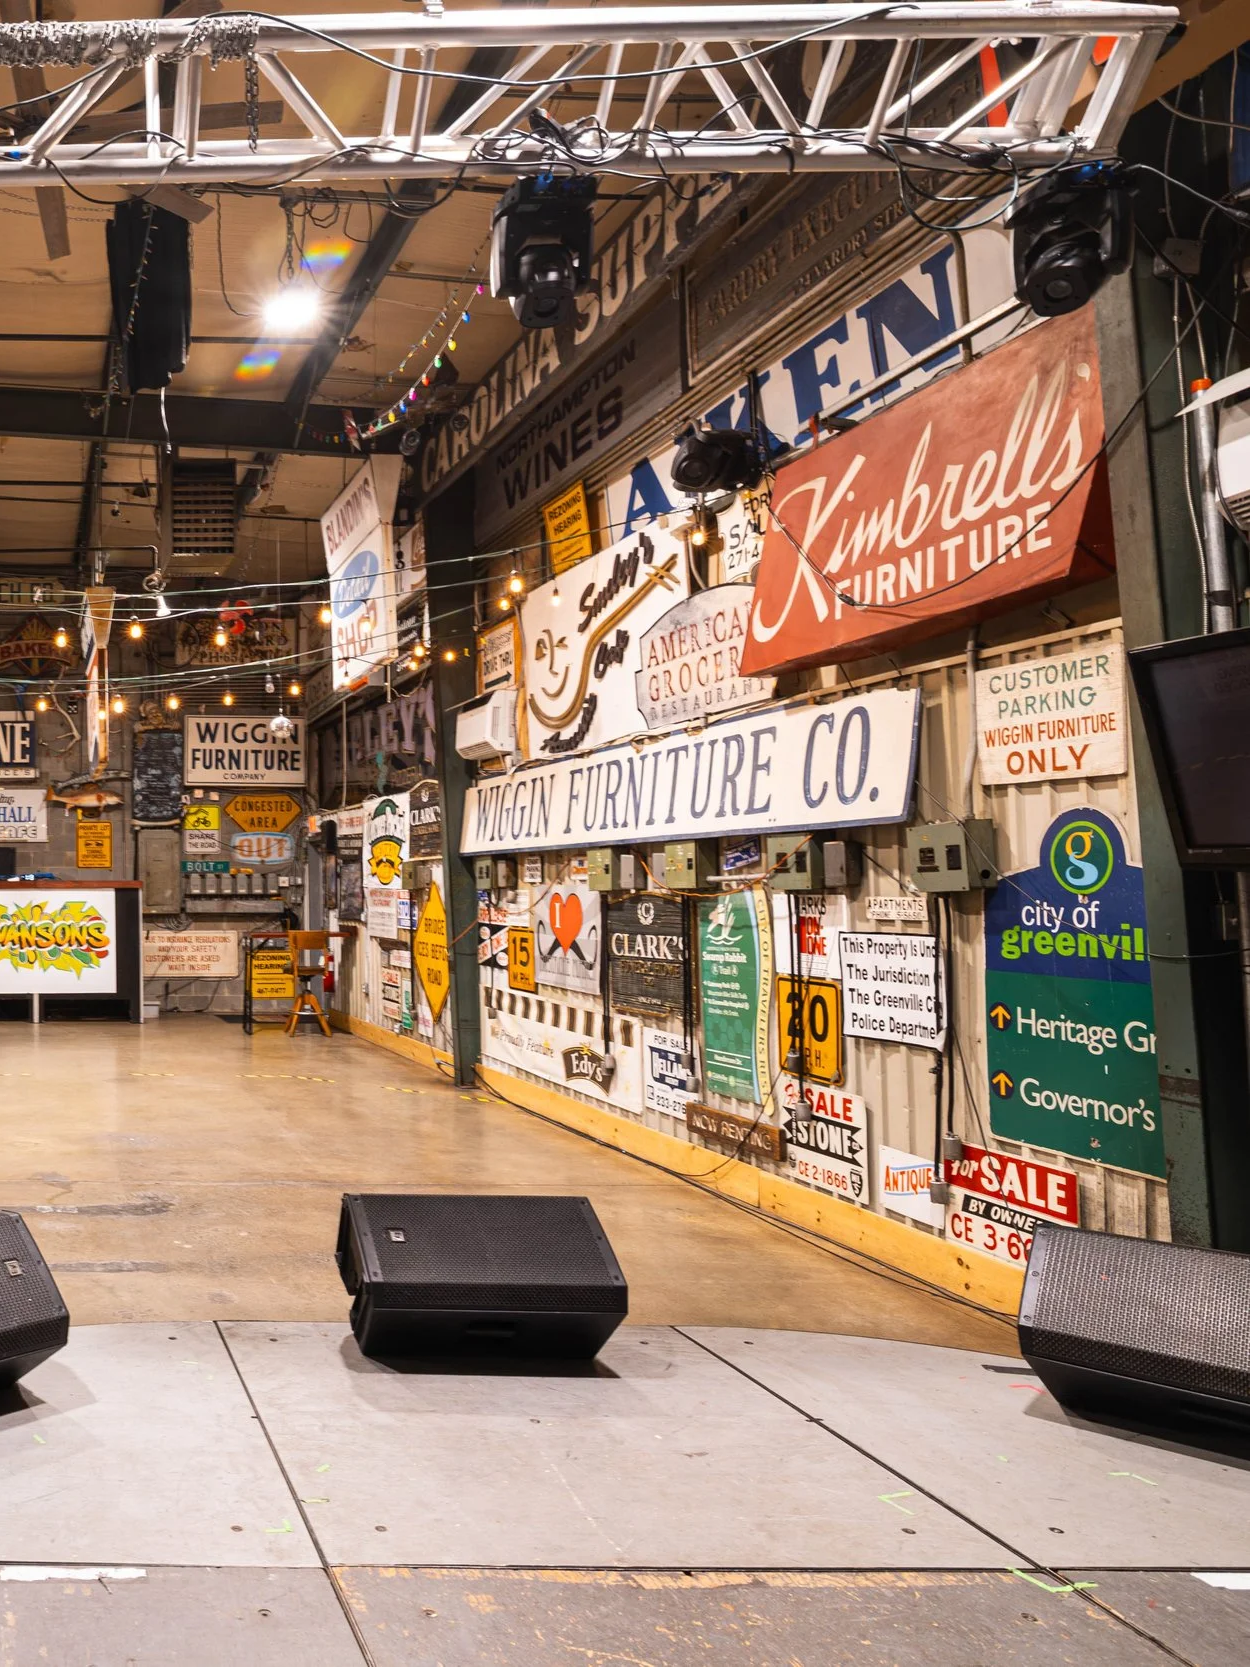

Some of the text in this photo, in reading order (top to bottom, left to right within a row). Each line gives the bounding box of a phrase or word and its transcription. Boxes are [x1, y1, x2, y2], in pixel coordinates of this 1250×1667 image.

[421, 328, 562, 494] CAROLINA
[496, 339, 638, 475] NORTHAMPTON
[502, 386, 625, 511] WINES
[547, 490, 582, 523] REZONING
[553, 510, 583, 536] HEARING
[833, 502, 1051, 620] FURNITURE
[336, 599, 378, 660] SHOP
[649, 645, 743, 703] GROCER
[988, 654, 1111, 696] CUSTOMER
[997, 685, 1097, 720] PARKING
[195, 722, 300, 745] WIGGN
[984, 712, 1118, 750] WIGGIN FURNITURE
[191, 749, 301, 771] FURNITURE
[475, 704, 880, 843] WIGGIN FURNITURE CO.
[1005, 743, 1091, 776] ONLY
[223, 772, 266, 781] COMPANY
[234, 800, 293, 813] CONGESTED
[249, 817, 278, 828] AREA
[236, 838, 288, 859] OUT
[186, 862, 214, 872] BOLT
[554, 902, 561, 929] I
[757, 898, 769, 935] CITY
[867, 899, 924, 911] APARTMENTS
[1021, 900, 1100, 933] city of
[423, 917, 445, 936] BRIDGE
[1000, 922, 1150, 962] greenvil
[145, 955, 186, 963] CUSTOMERS
[511, 937, 530, 968] 15
[702, 951, 748, 964] Swamp Rabbit
[762, 940, 770, 959] OF
[842, 937, 918, 960] This Property Is
[168, 963, 211, 971] WAIT INSIDE
[426, 967, 442, 987] ROAD
[718, 964, 732, 975] Trail
[846, 963, 930, 987] The Jurisdiction
[758, 968, 770, 1056] TRAVELERS
[849, 987, 923, 1012] The Greenville
[653, 1034, 667, 1046] FOR
[851, 1012, 936, 1040] Police Departme
[1016, 1006, 1118, 1056] Heritage
[499, 1028, 554, 1059] Proudly Feature
[804, 1086, 854, 1123] SALE
[1019, 1076, 1156, 1132] Governor's
[692, 1112, 772, 1152] NOW RENTING
[797, 1119, 853, 1159] STONE
[798, 1159, 848, 1192] CE 2-1866
[980, 1155, 1068, 1217] SALE
[968, 1197, 987, 1216] BY
[951, 1213, 975, 1243] CE
